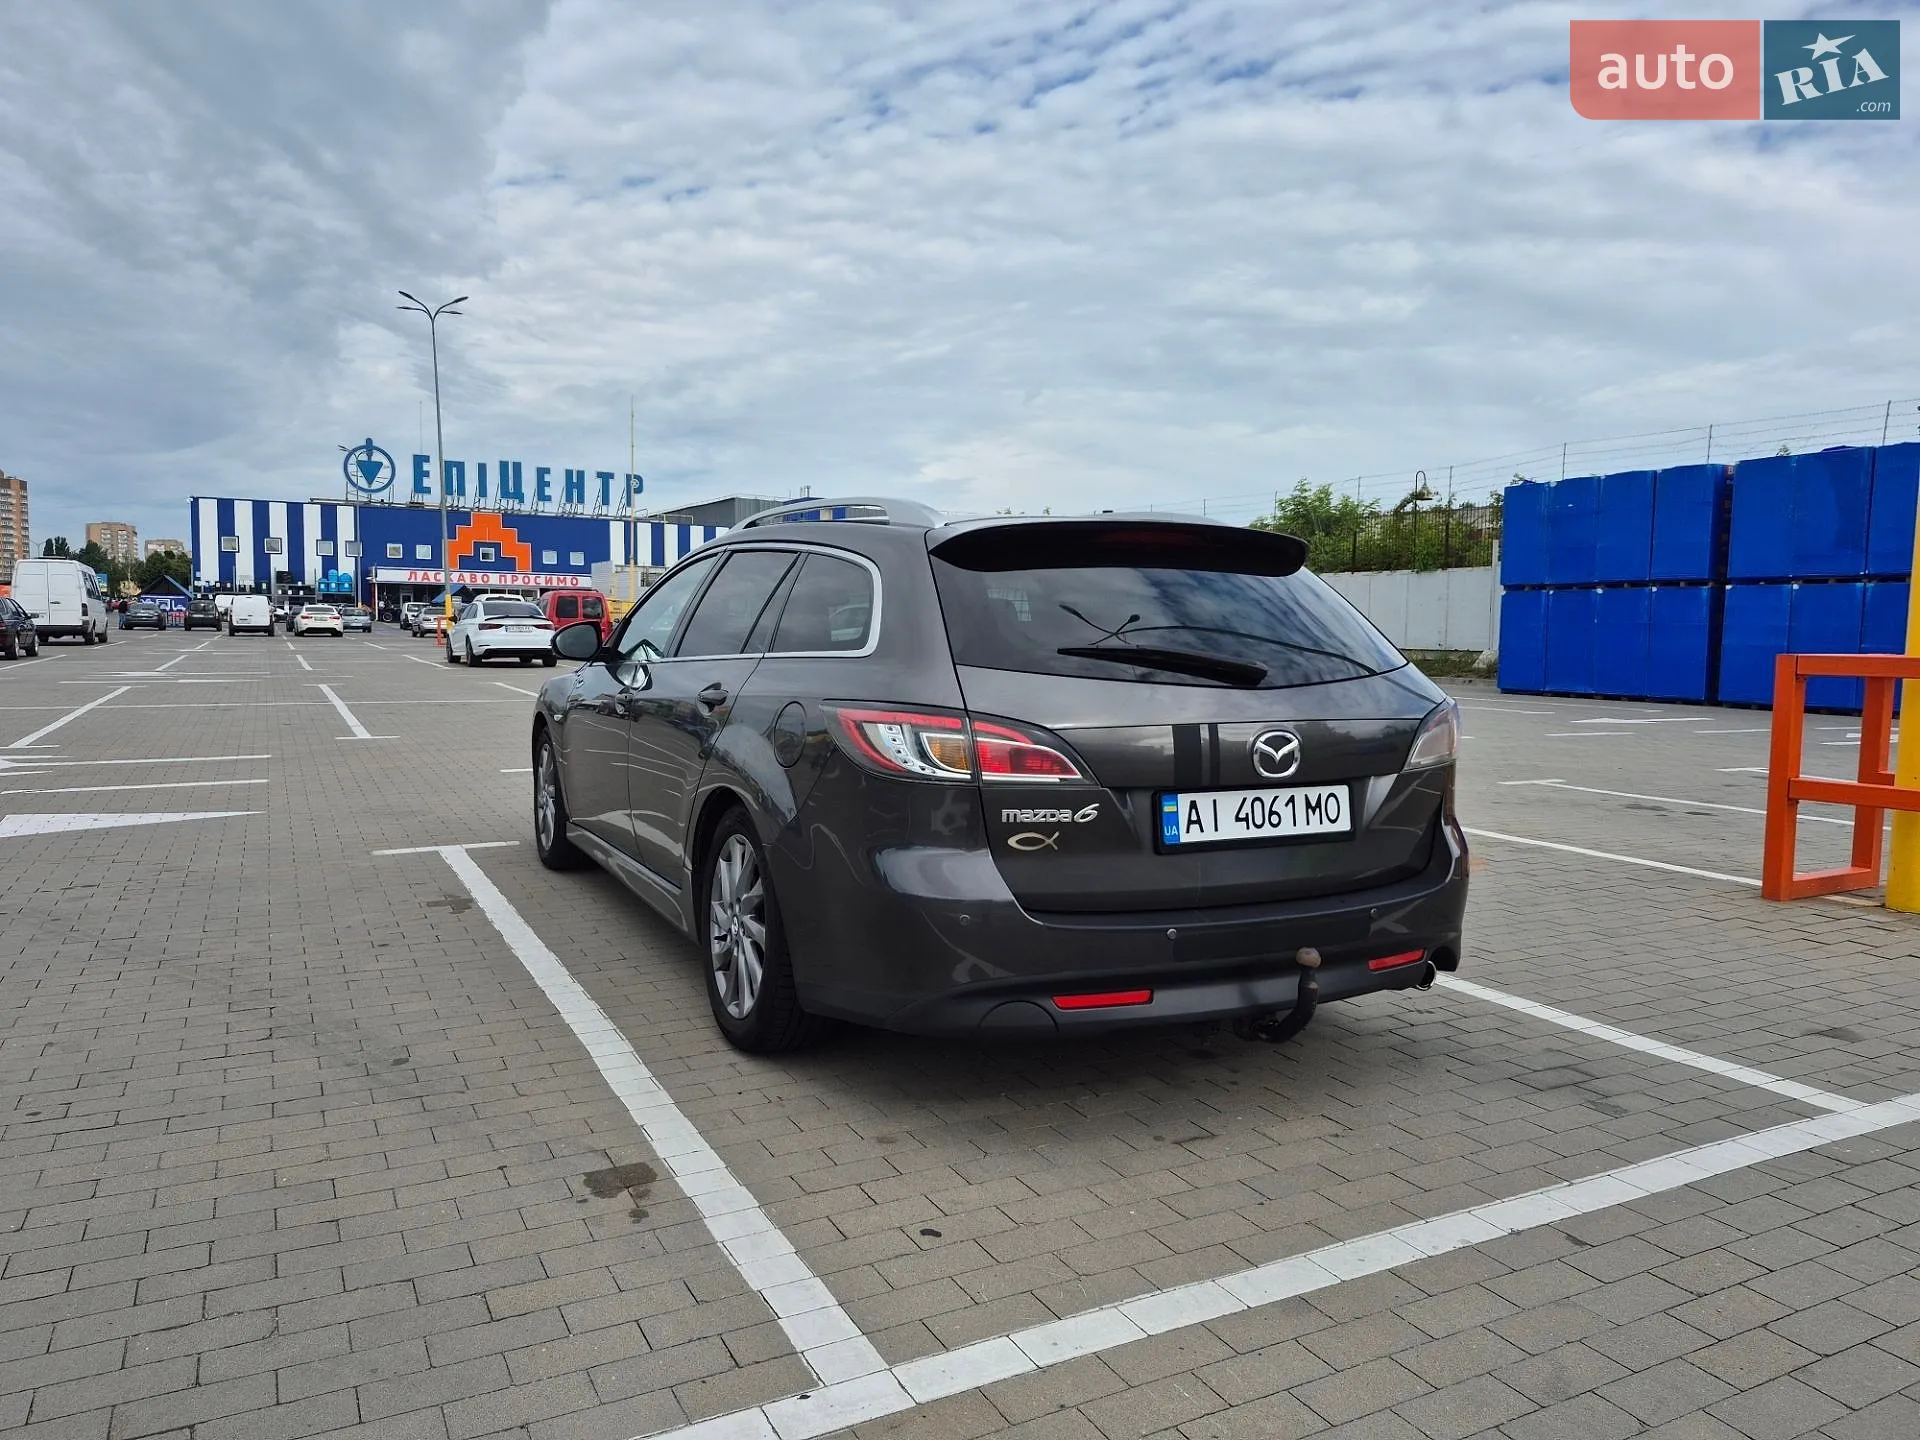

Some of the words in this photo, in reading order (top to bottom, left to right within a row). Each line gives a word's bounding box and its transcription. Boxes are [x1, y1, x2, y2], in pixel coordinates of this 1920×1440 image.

[412, 454, 644, 508] ЕПІЦЕНТР
[498, 574, 580, 587] ПРОСИМО
[1234, 794, 1298, 830] 4061
[1164, 824, 1179, 836] UA
